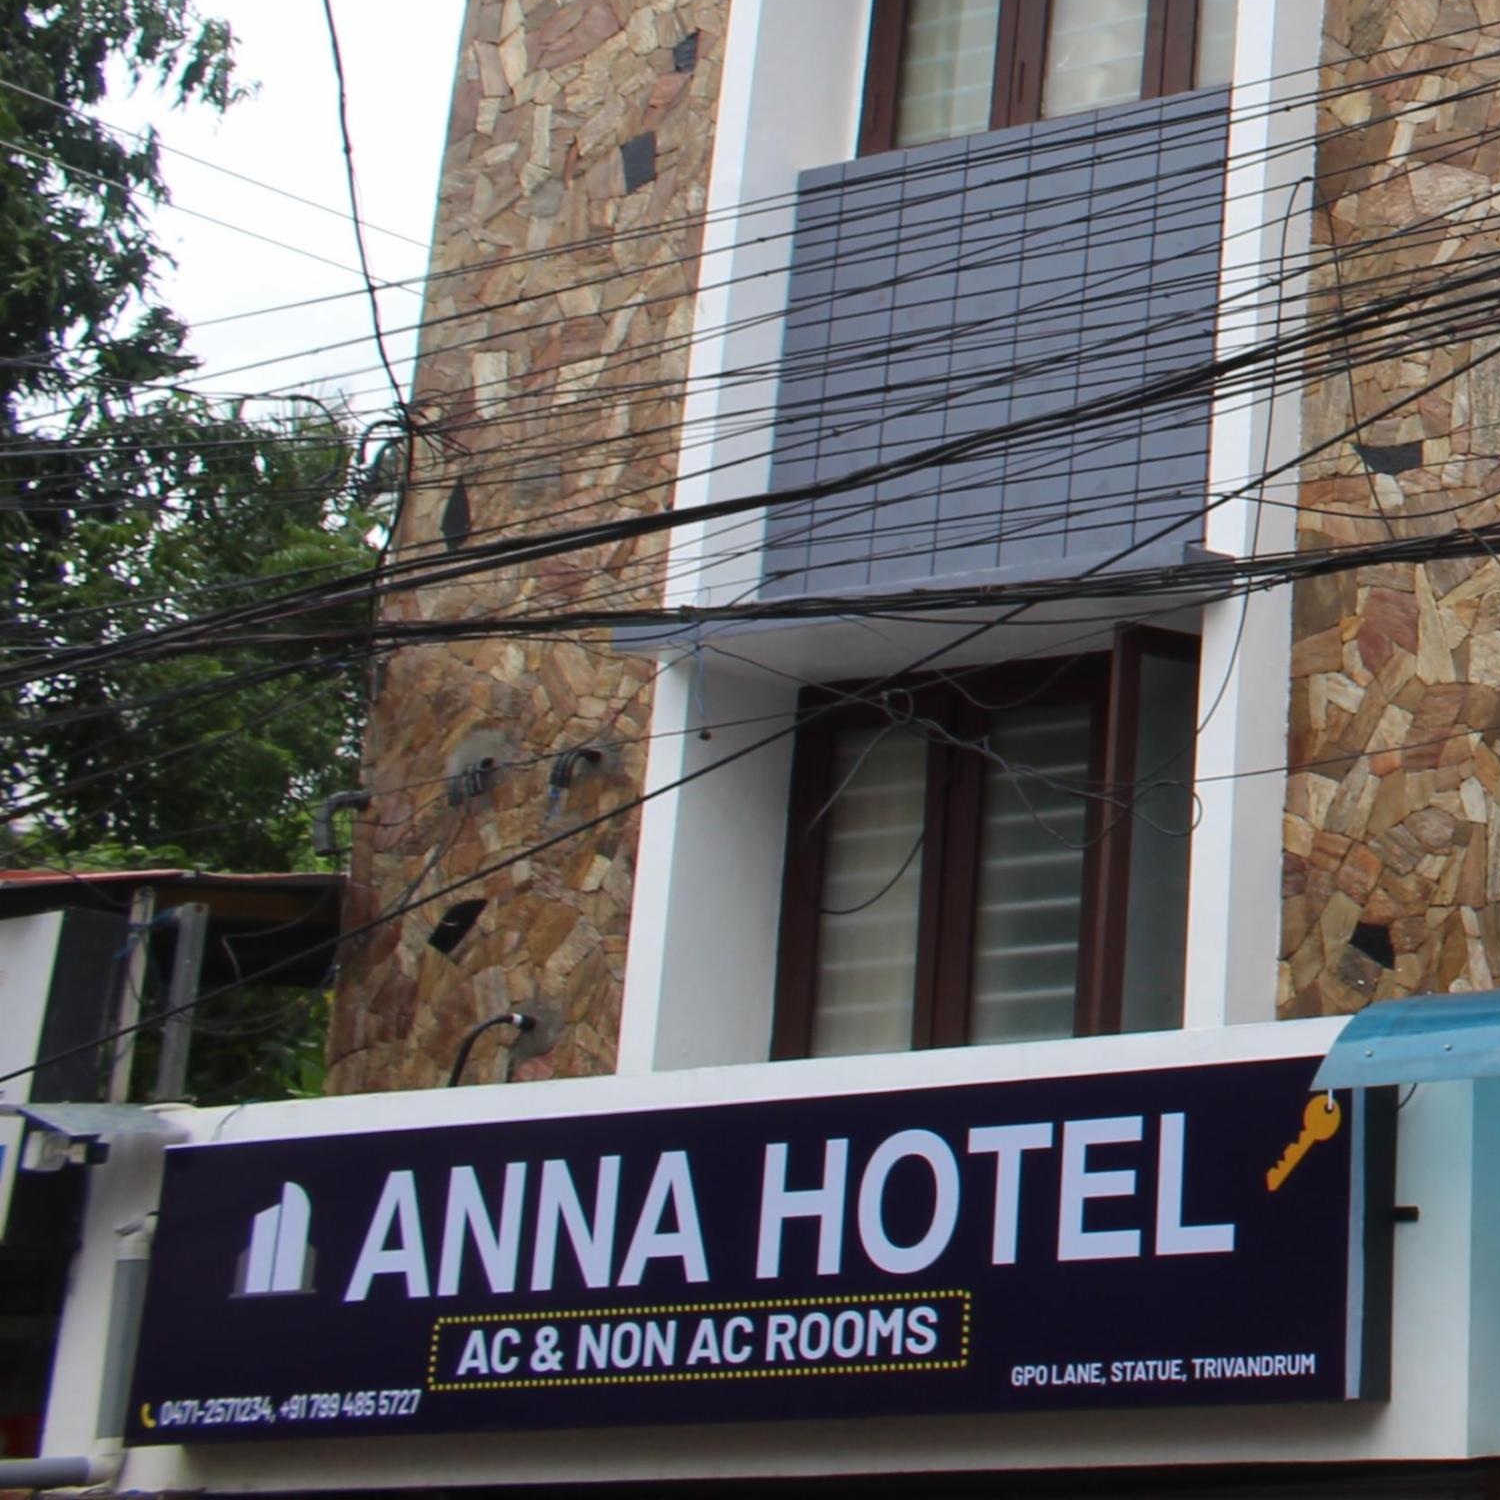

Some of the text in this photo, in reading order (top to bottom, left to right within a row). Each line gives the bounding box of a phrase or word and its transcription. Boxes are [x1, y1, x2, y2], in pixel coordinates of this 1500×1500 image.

[343, 1112, 1236, 1303] ANNA HOTEL
[456, 1304, 938, 1376] AC & NON AC ROOMS
[1010, 1352, 1316, 1387] GPO LANE, STATUE, TRIVANDRUM
[309, 1393, 340, 1418] 799
[342, 1391, 377, 1416] 485
[378, 1388, 422, 1415] 5727
